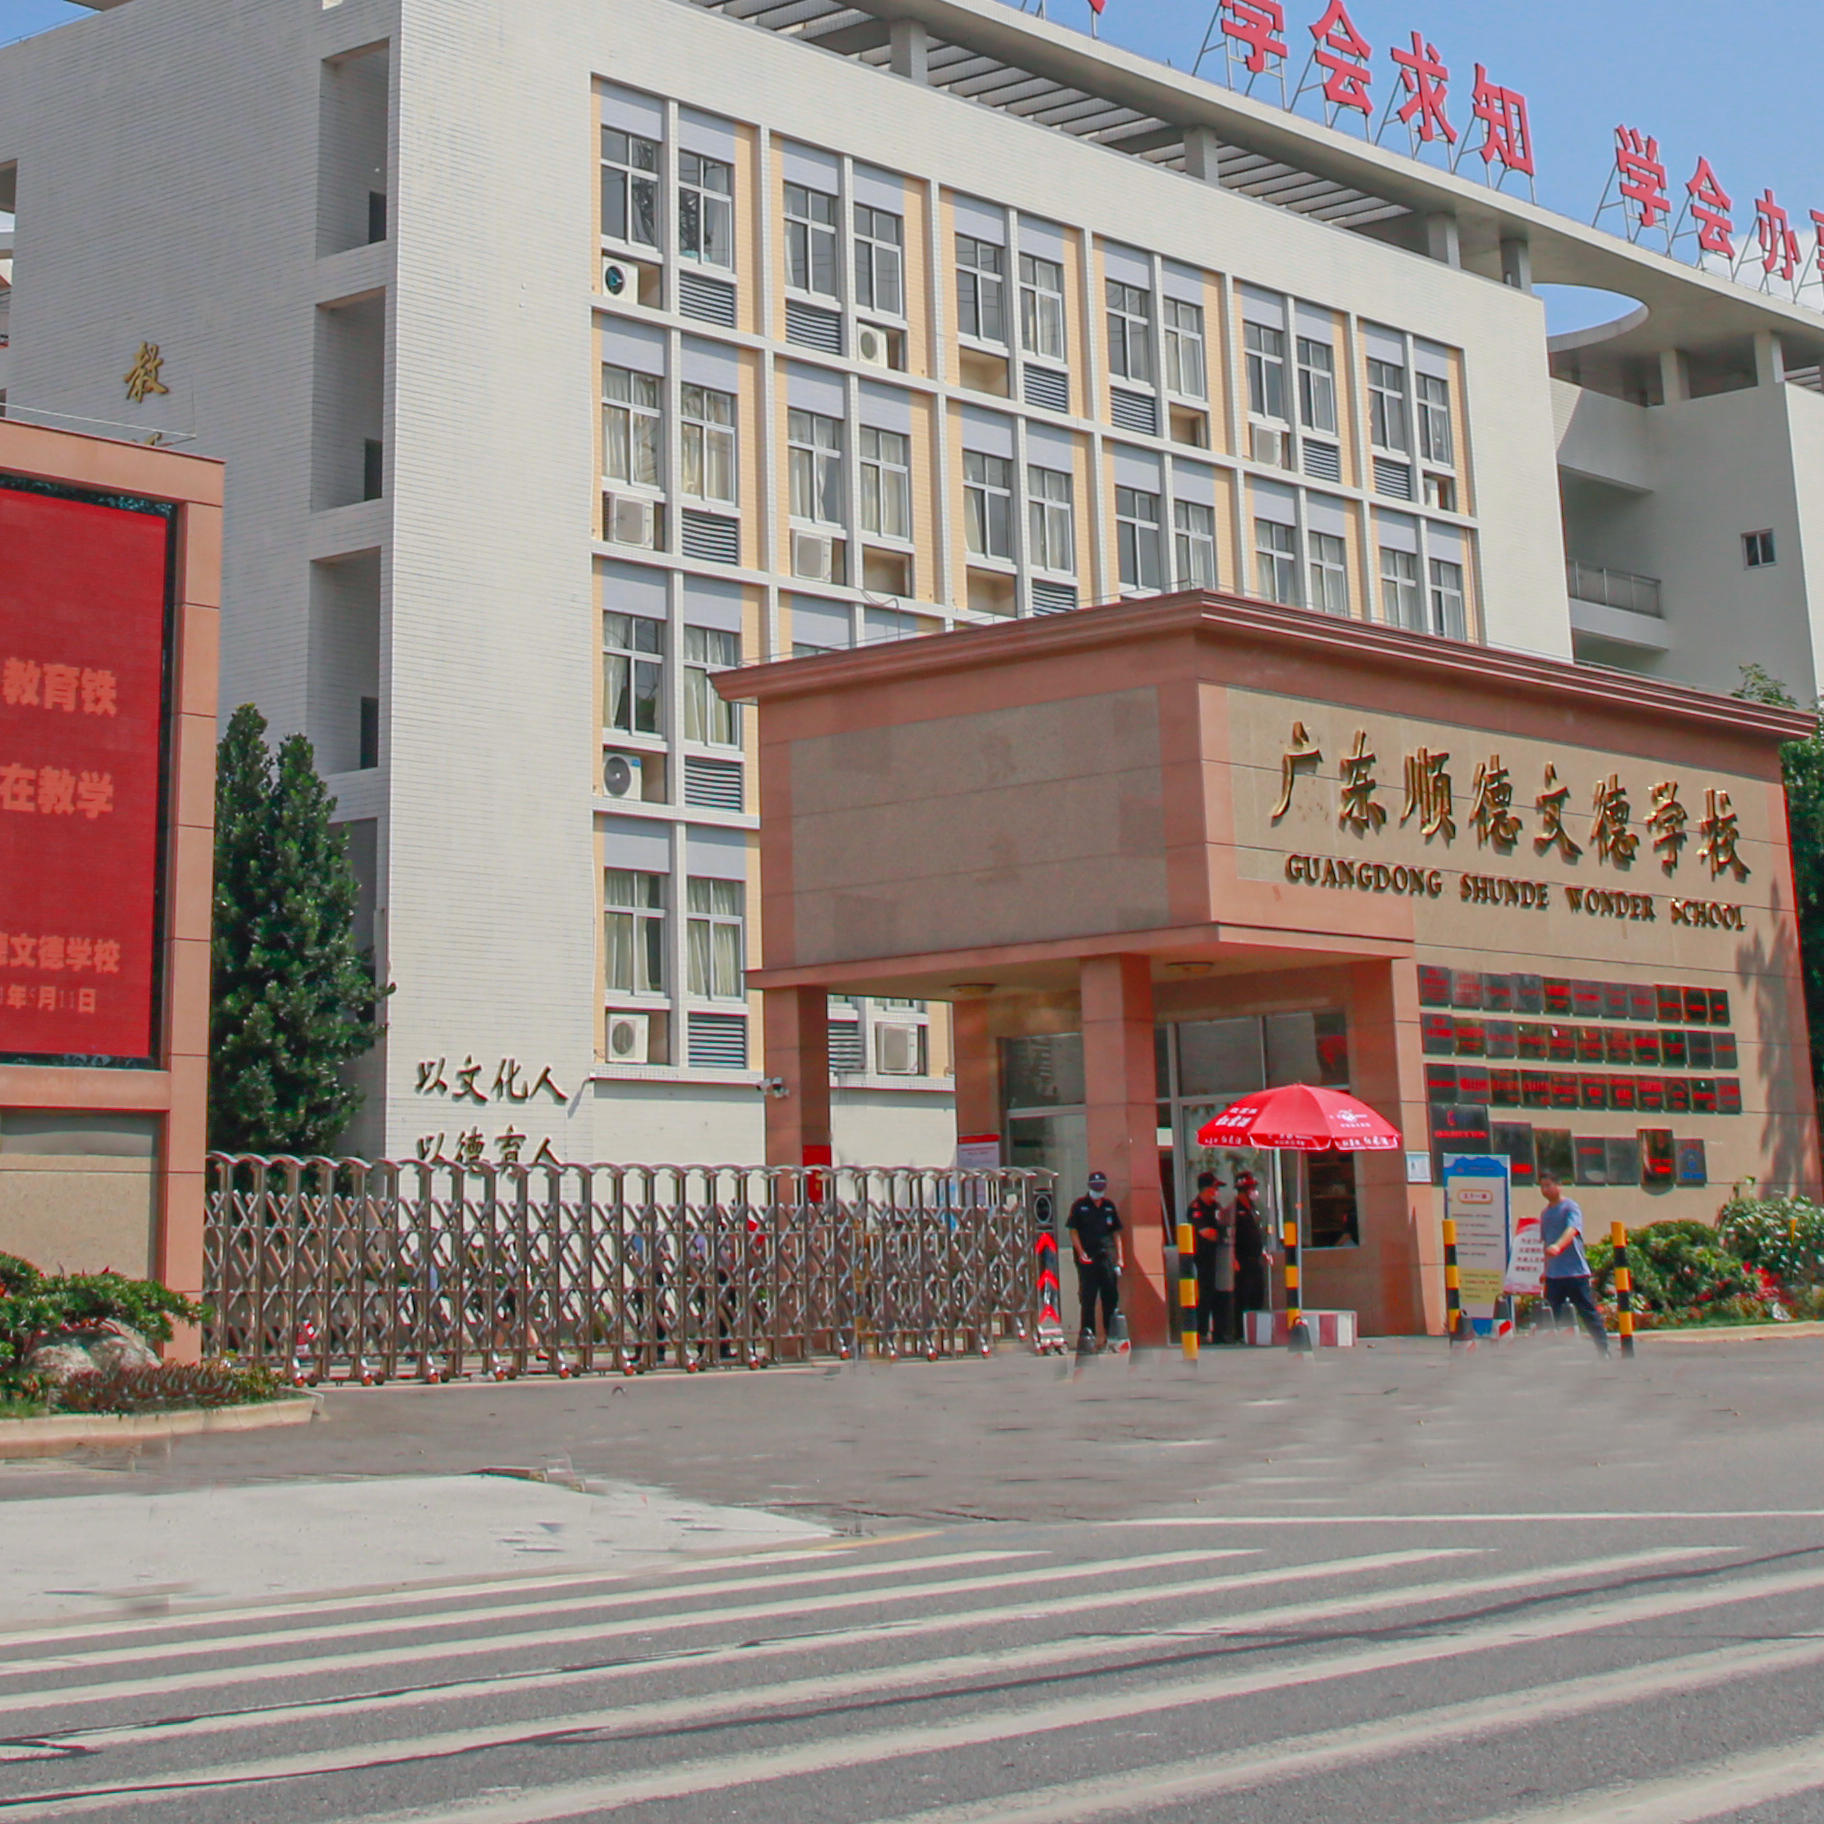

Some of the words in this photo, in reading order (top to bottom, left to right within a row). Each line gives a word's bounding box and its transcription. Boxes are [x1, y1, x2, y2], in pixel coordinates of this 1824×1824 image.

[1271, 721, 1752, 882] 广东顺德文德学校
[1286, 854, 1443, 897] GUANGDONG
[1459, 873, 1550, 910] SHUNDE
[1565, 886, 1656, 922] WONDER
[1671, 897, 1746, 931] SCHOOL
[415, 1054, 569, 1105] 以文化人
[416, 1124, 562, 1178] 以德育人
